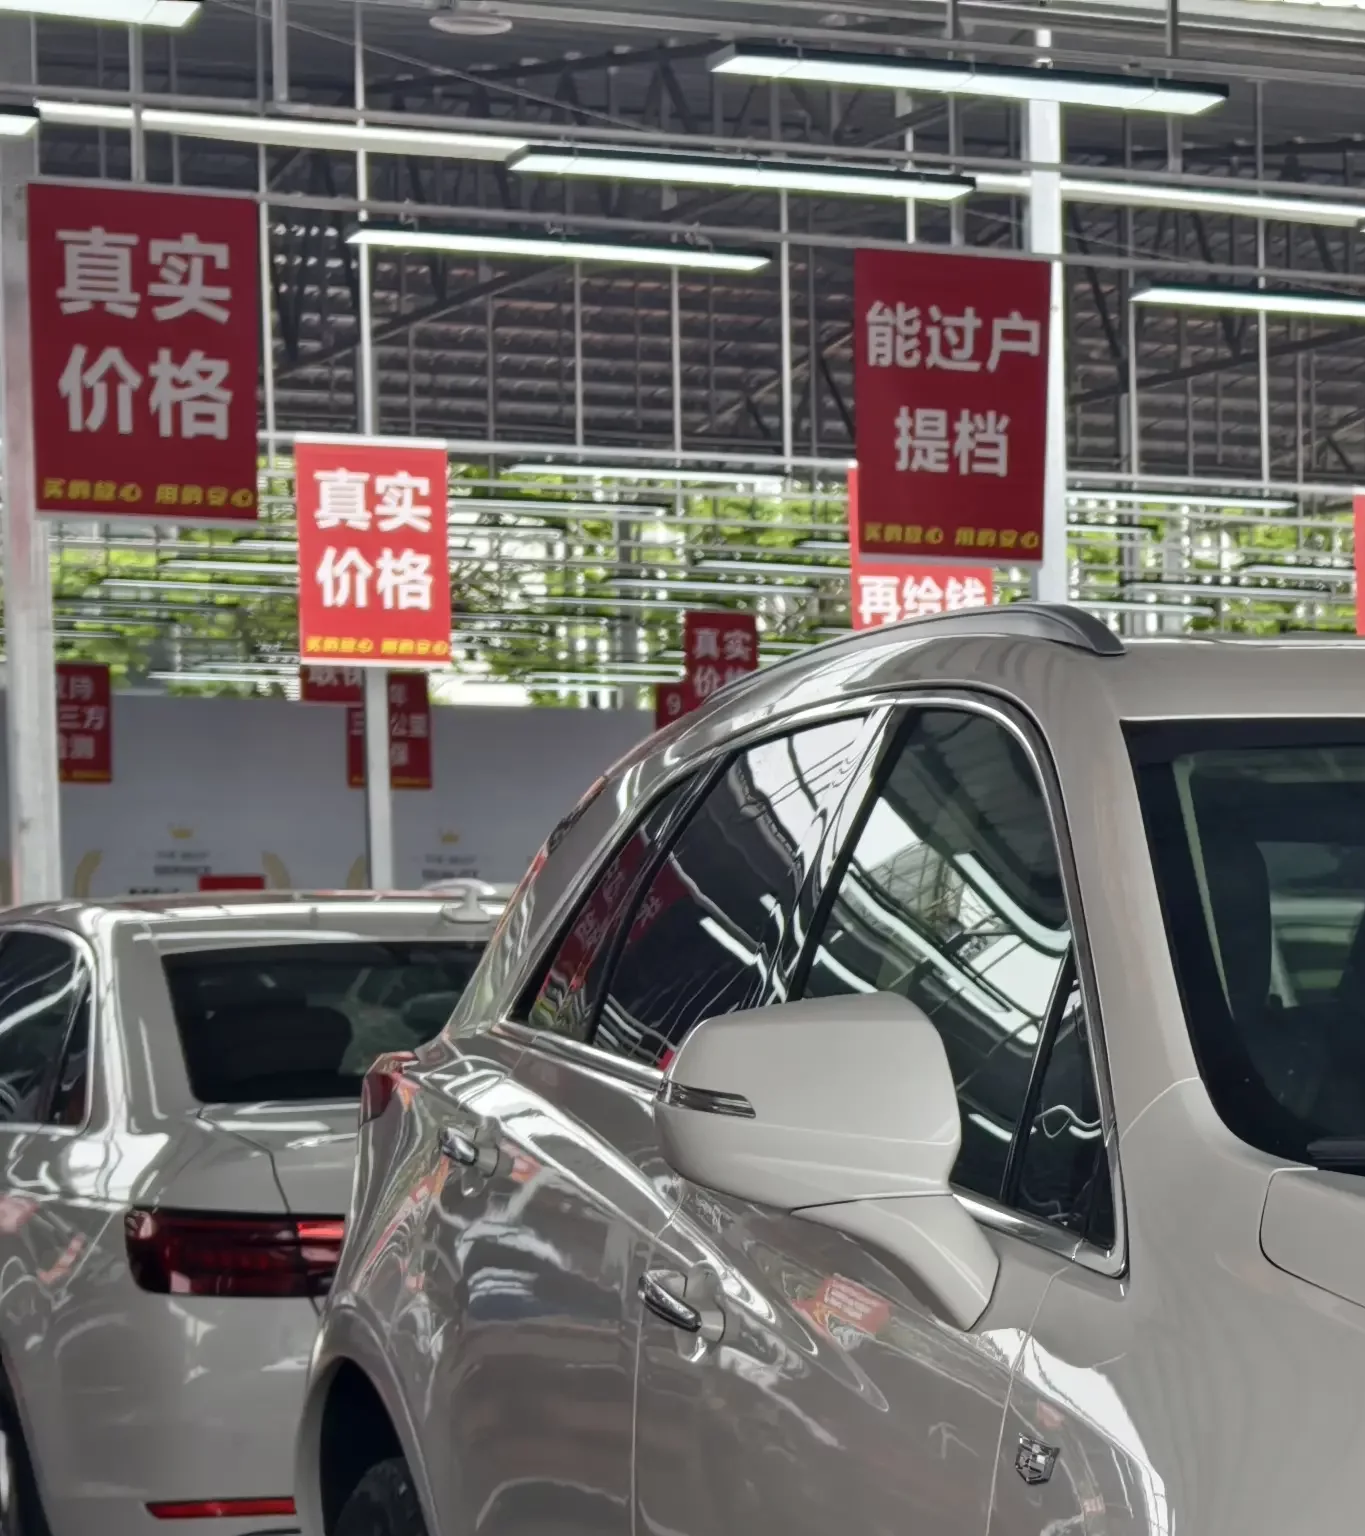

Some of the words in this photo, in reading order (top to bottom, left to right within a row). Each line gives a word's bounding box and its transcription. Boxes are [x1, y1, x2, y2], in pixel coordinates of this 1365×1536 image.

[56, 226, 231, 323] 真实
[866, 301, 1041, 373] 能过户
[59, 344, 233, 440] 价格
[895, 407, 1010, 477] 提档
[314, 467, 431, 532] 真实
[316, 547, 433, 611] 价格
